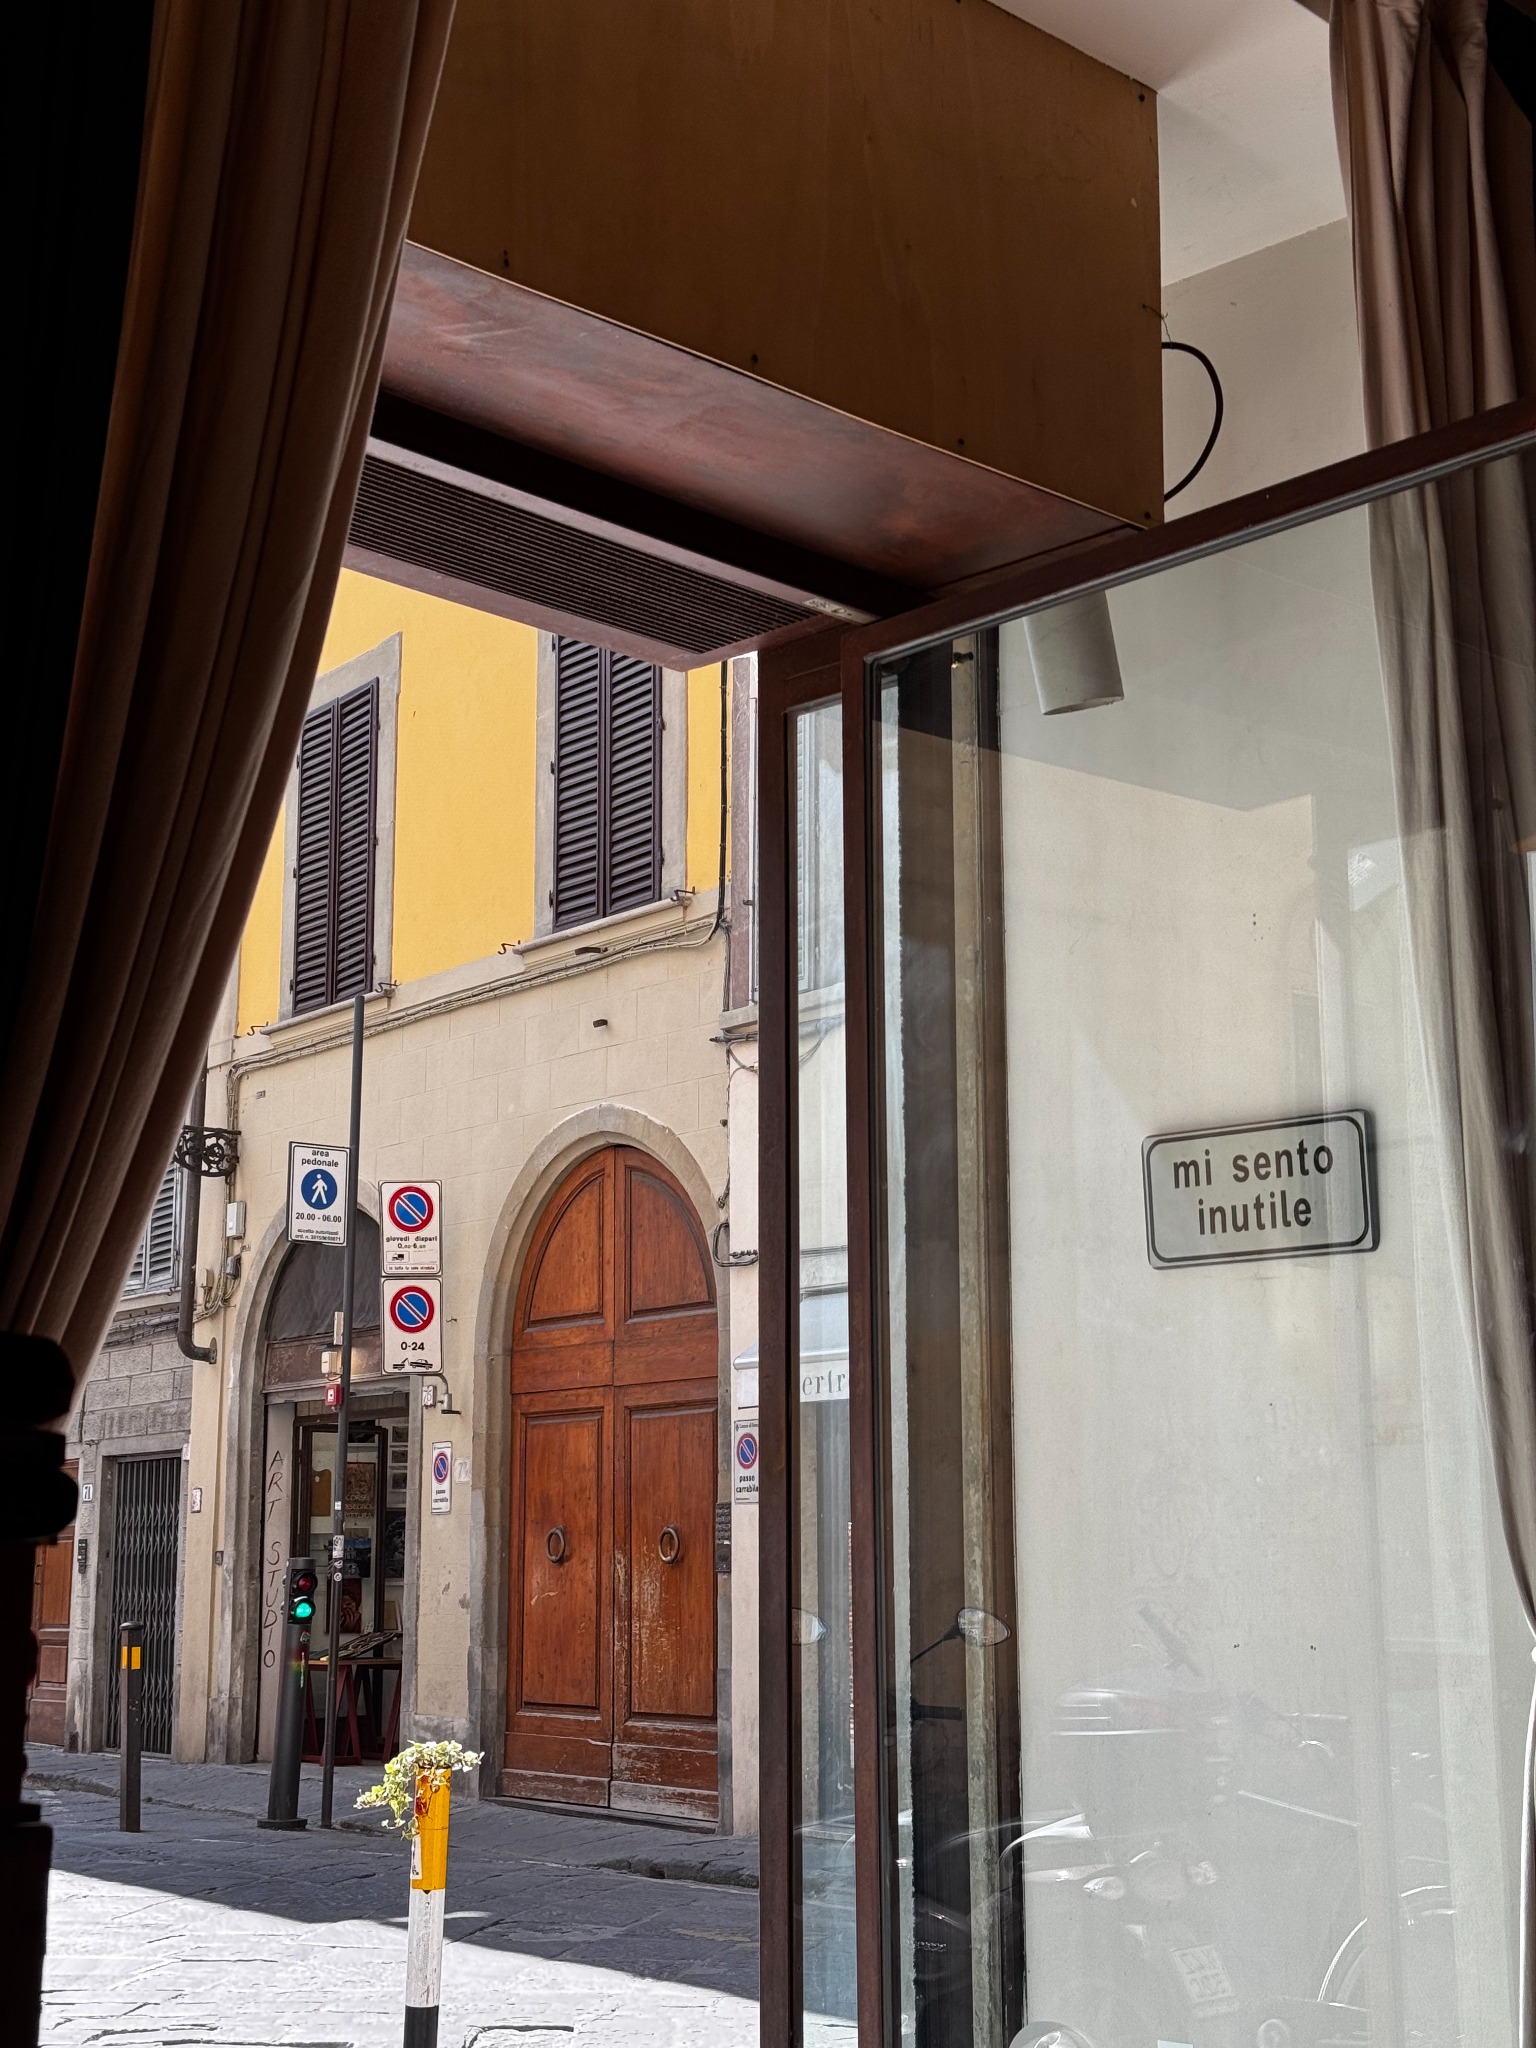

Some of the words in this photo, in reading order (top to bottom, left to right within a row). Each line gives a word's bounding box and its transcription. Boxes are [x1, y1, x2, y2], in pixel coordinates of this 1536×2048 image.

[301, 1158, 339, 1167] pedonale
[1173, 1149, 1212, 1189] mi
[1232, 1138, 1334, 1183] sento
[295, 1212, 315, 1221] 20.00
[322, 1214, 342, 1224] 06.00
[1198, 1190, 1312, 1236] inutile
[400, 1341, 425, 1351] 0-24
[266, 1450, 284, 1523] ART
[739, 1474, 756, 1483] passo
[263, 1541, 282, 1668] STUDIO
